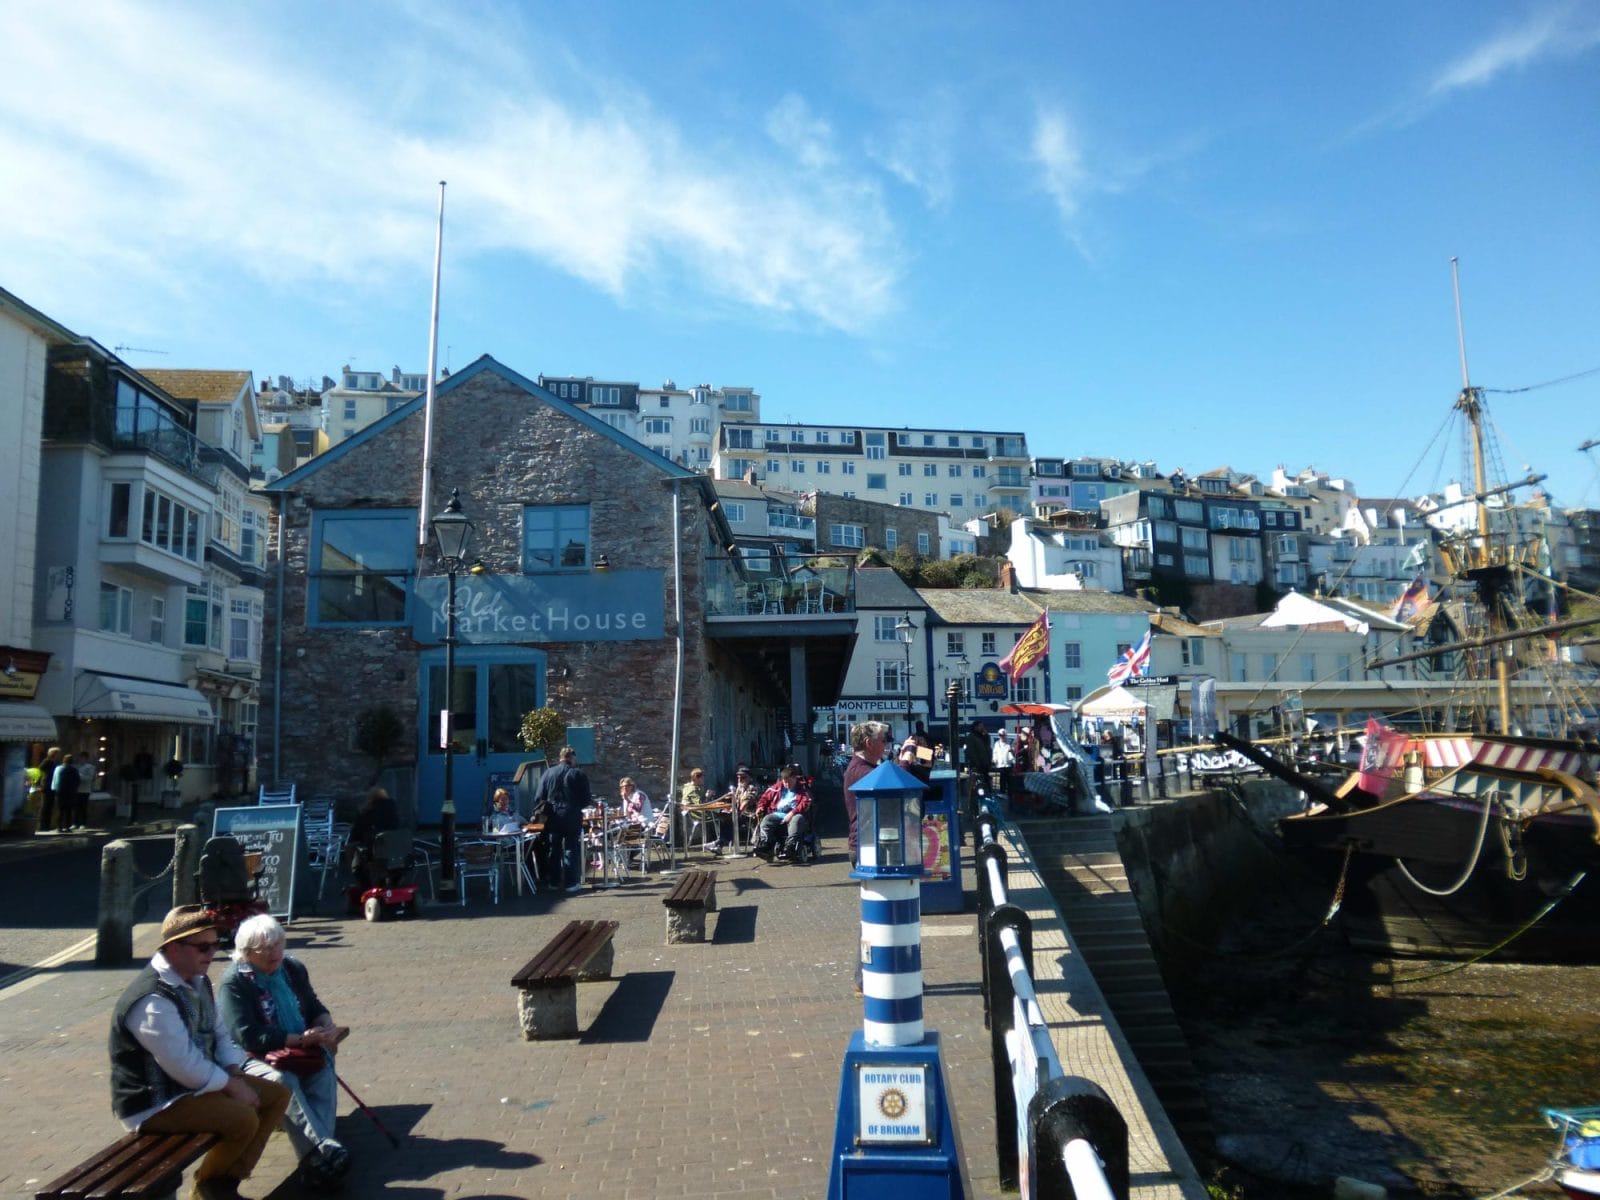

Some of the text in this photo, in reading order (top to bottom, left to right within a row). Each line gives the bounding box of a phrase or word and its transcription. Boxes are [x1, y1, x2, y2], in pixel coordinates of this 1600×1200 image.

[440, 585, 503, 617] Old
[431, 607, 647, 633] Market House
[838, 701, 914, 711] MONTPELLIER
[864, 1073, 922, 1084] ROTARY CLUB
[868, 1124, 920, 1136] OF BRIXHAM
